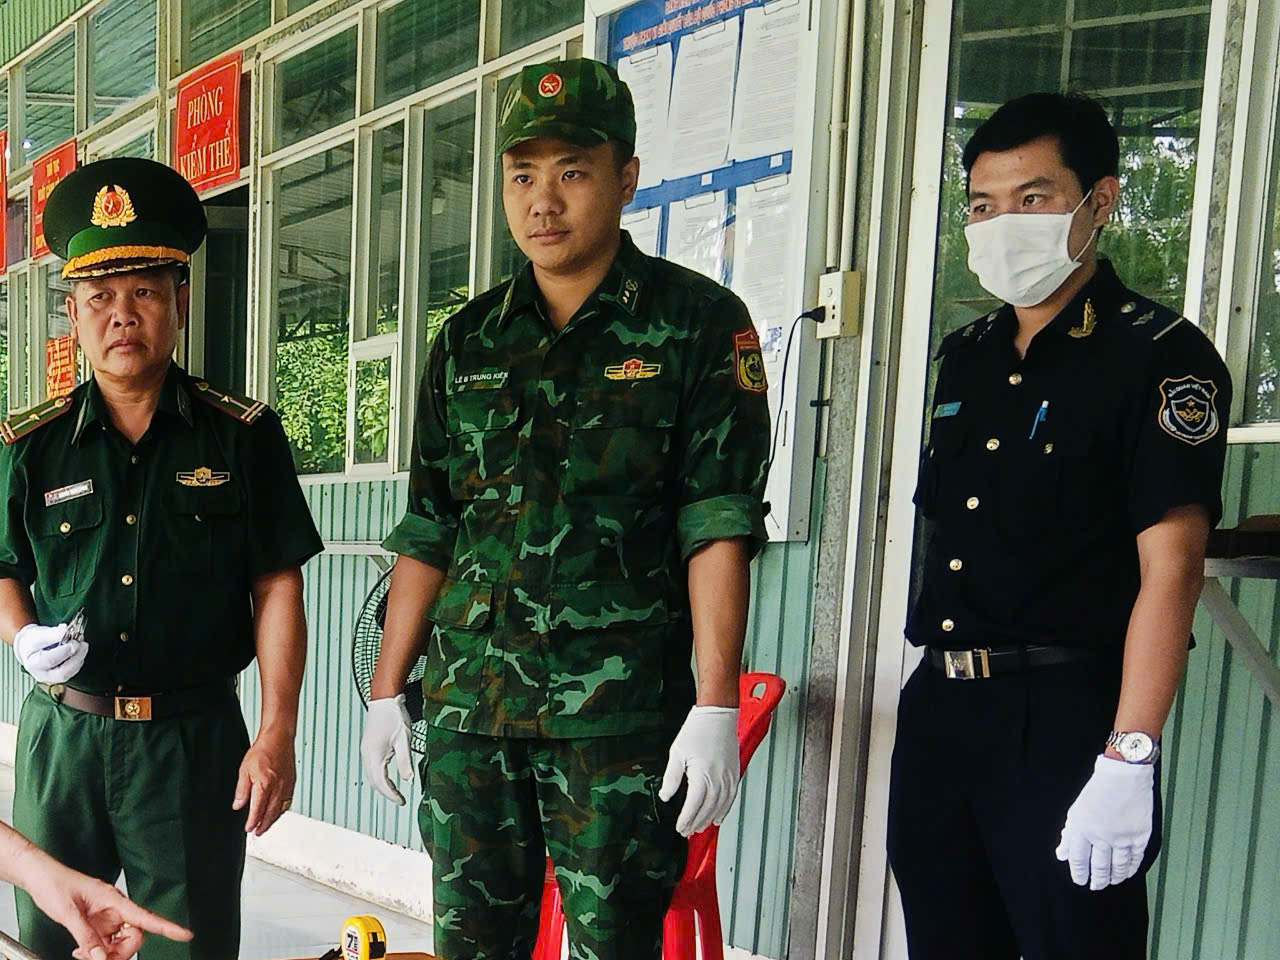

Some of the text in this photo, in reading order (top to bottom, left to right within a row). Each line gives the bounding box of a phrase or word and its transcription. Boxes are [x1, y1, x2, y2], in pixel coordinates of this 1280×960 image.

[187, 85, 224, 129] PHÒNG
[179, 120, 232, 181] KIỂM THỂ
[469, 373, 492, 381] TRUNG
